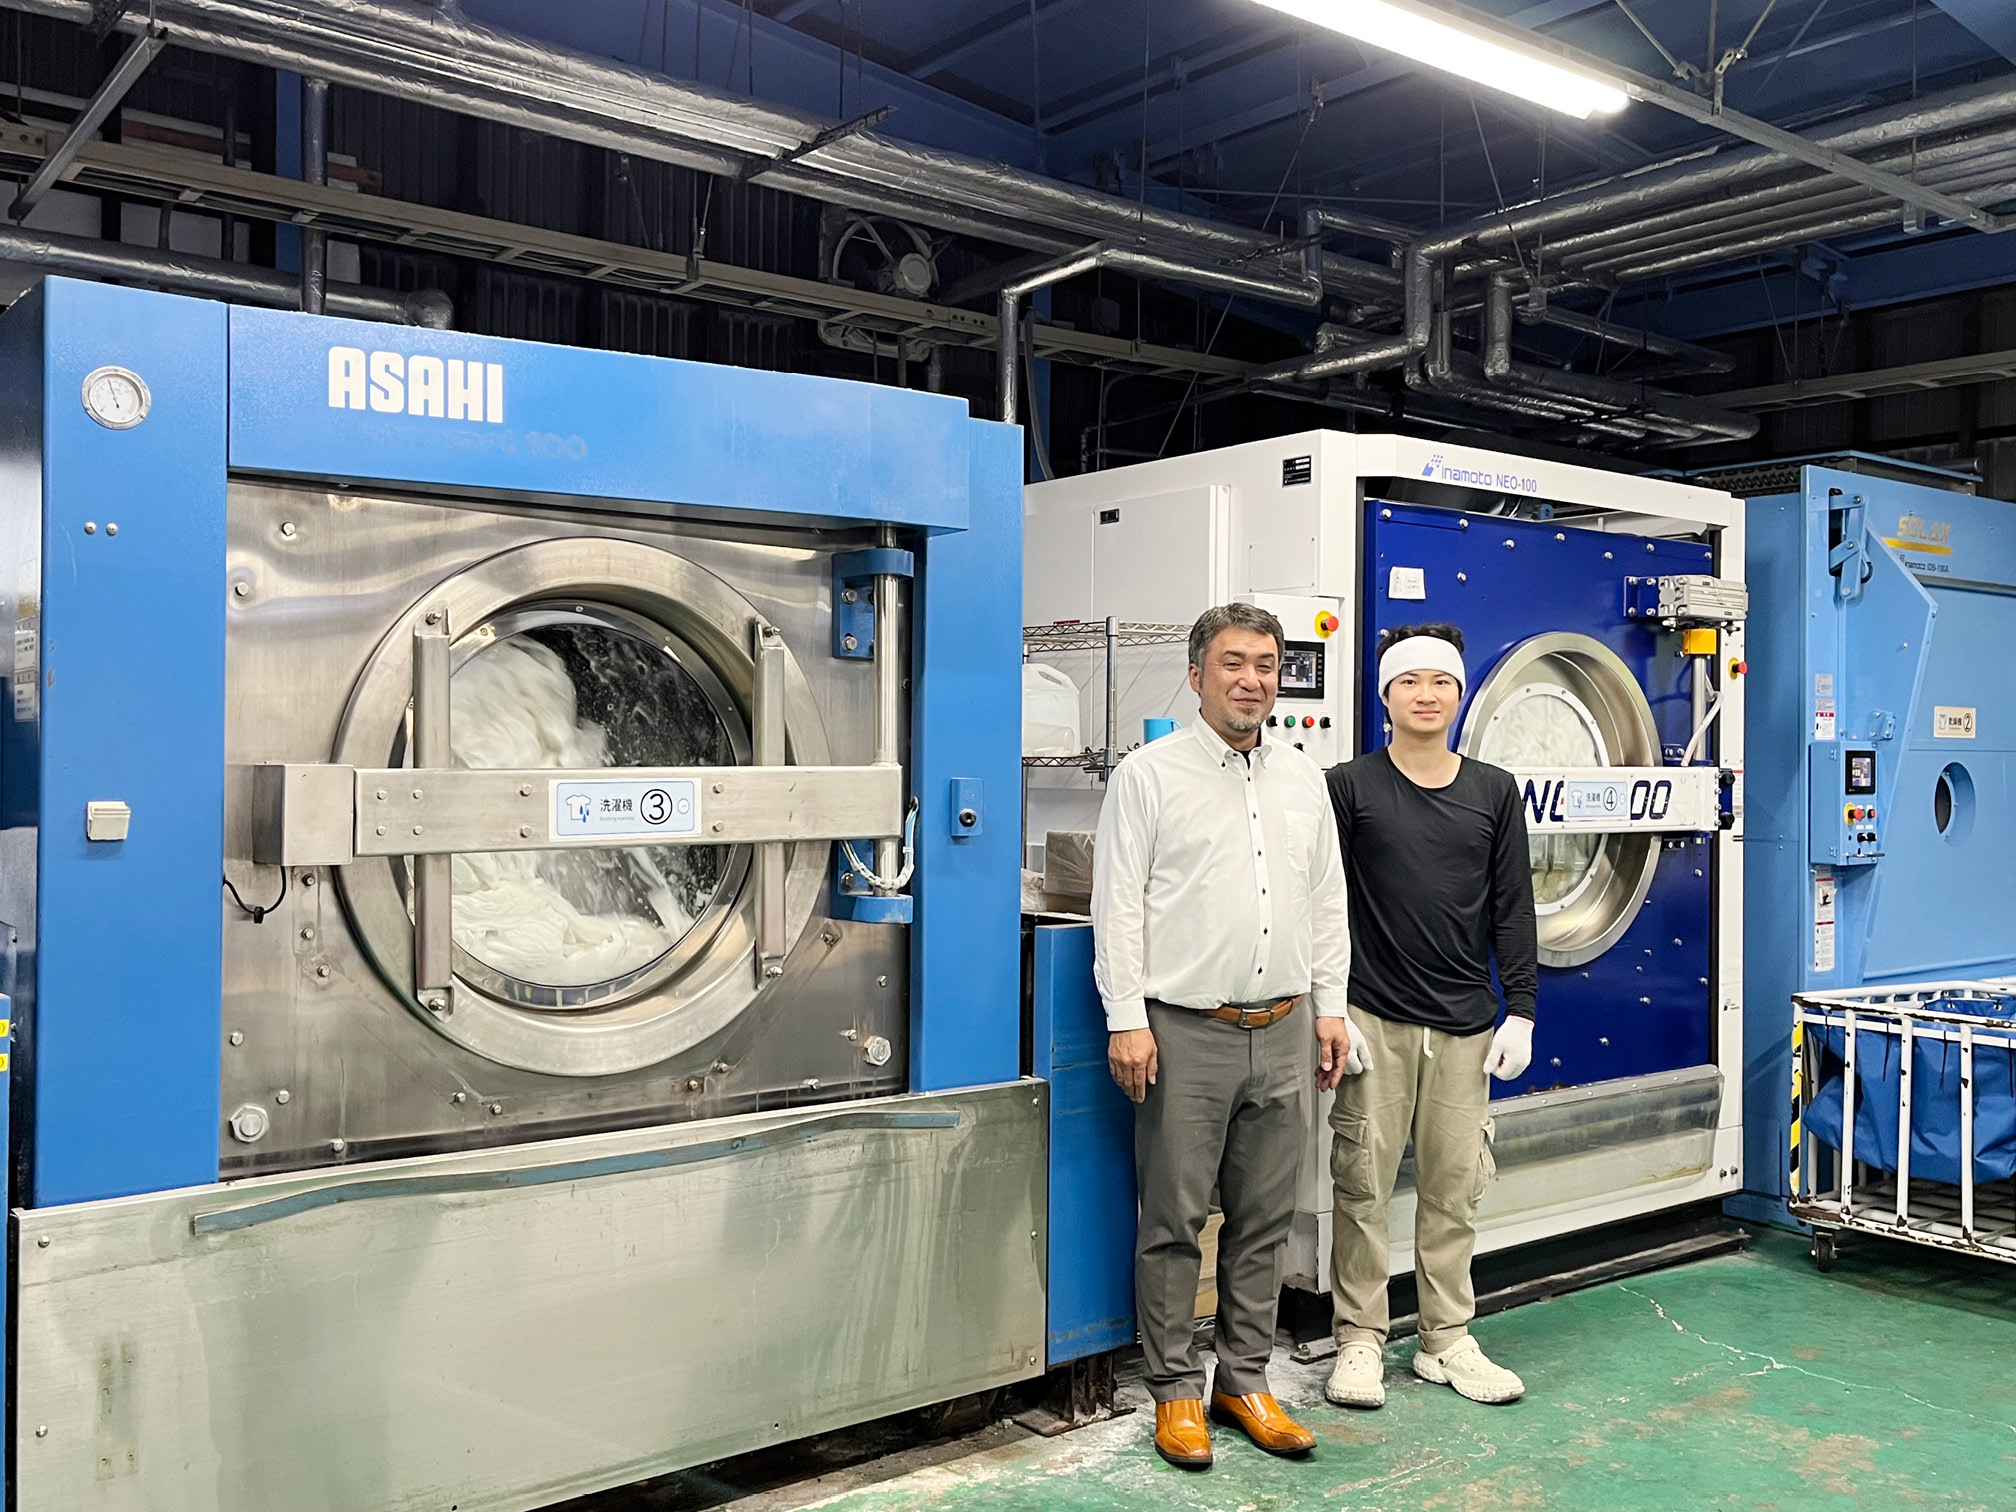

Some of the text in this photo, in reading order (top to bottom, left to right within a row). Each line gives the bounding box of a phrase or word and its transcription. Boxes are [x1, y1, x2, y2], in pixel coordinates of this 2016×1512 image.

[328, 346, 503, 424] ASAHI
[1496, 473, 1537, 493] NEO-100
[600, 798, 633, 812] 洗濯機
